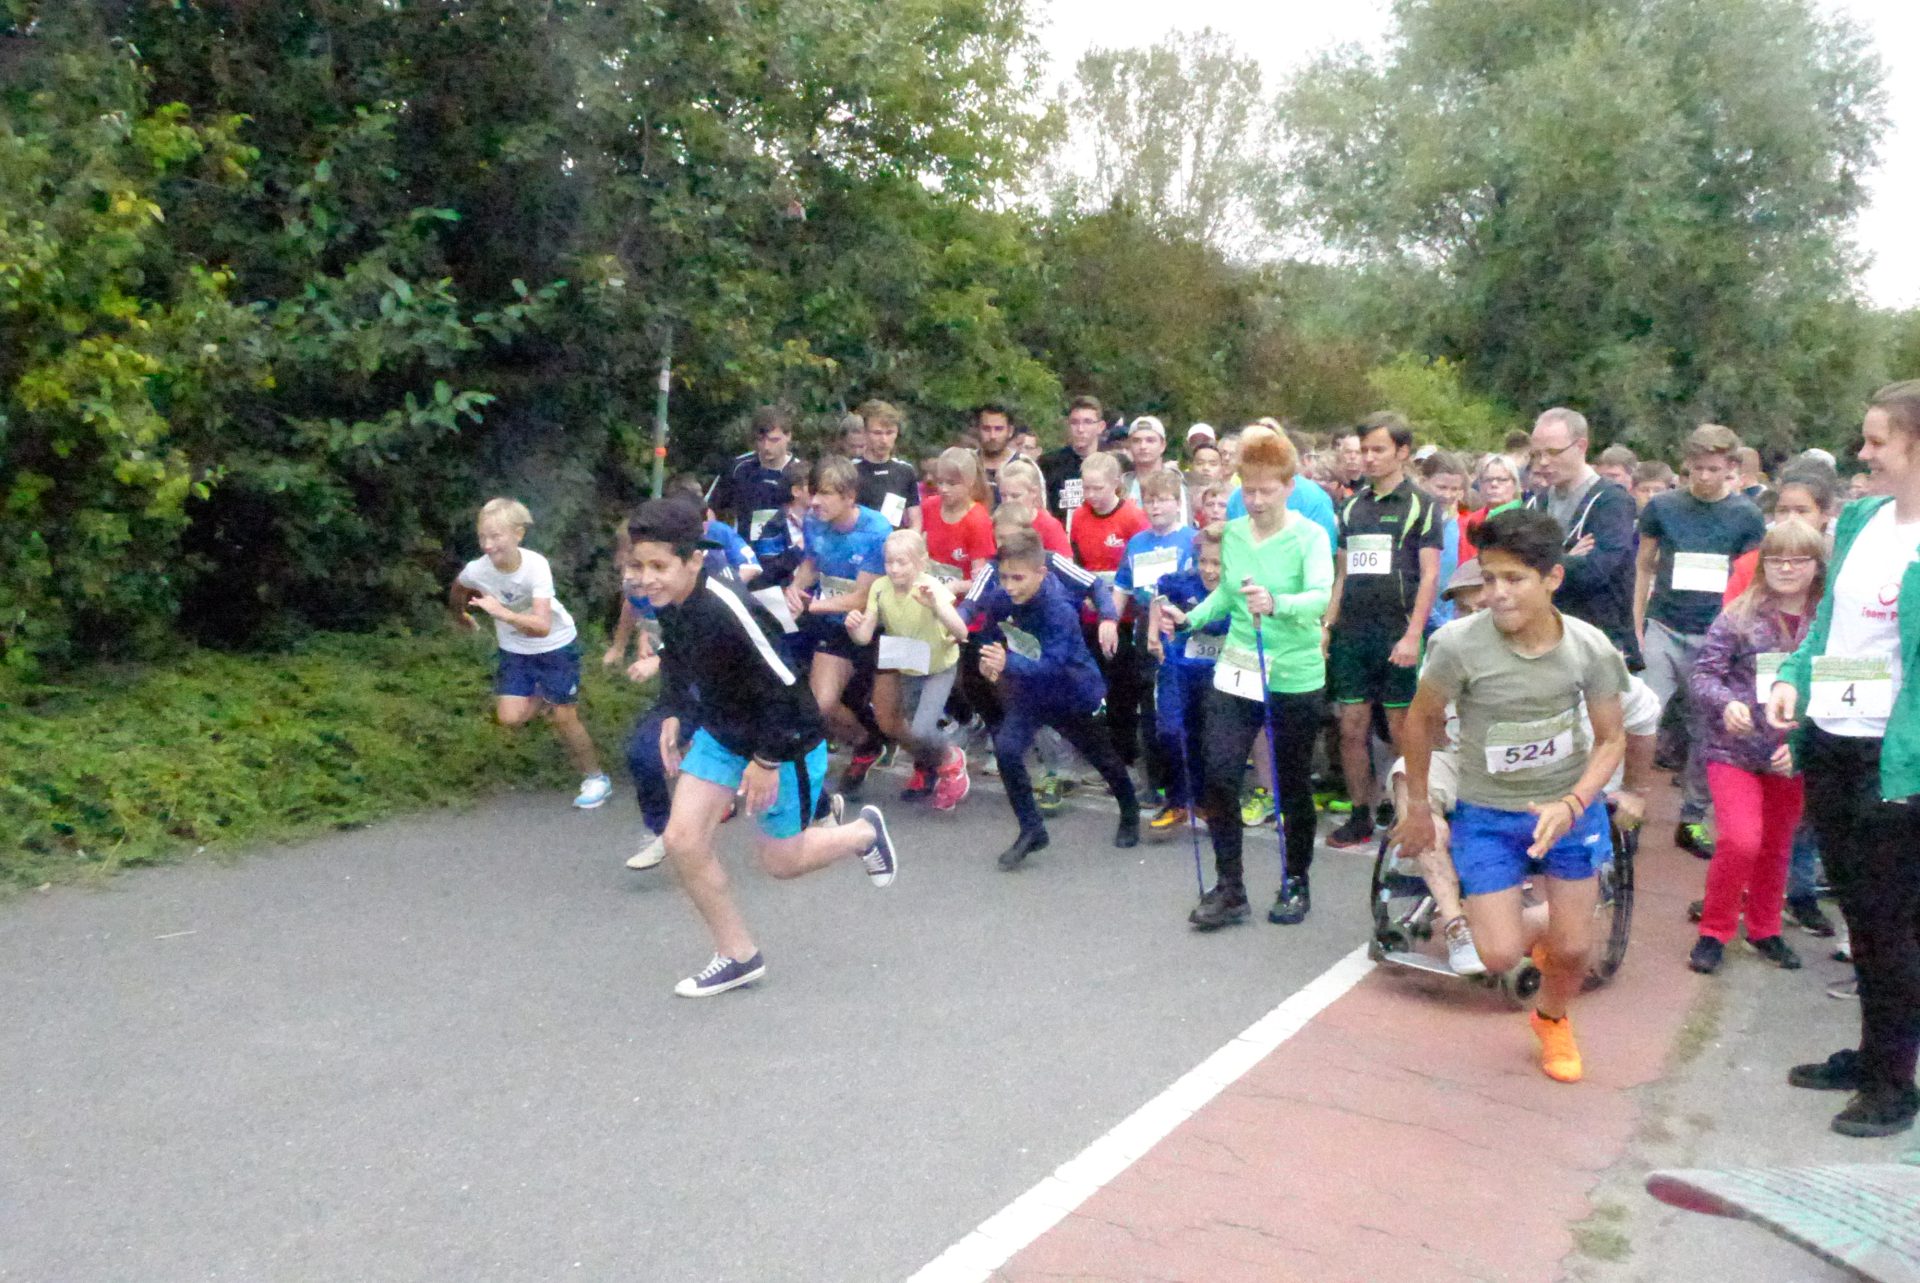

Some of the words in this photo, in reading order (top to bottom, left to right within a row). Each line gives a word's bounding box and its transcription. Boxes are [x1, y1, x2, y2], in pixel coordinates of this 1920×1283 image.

[1352, 552, 1378, 567] 606
[1197, 644, 1223, 657] 39
[1233, 670, 1242, 687] 1
[1841, 683, 1857, 707] 4
[1505, 738, 1556, 765] 524
